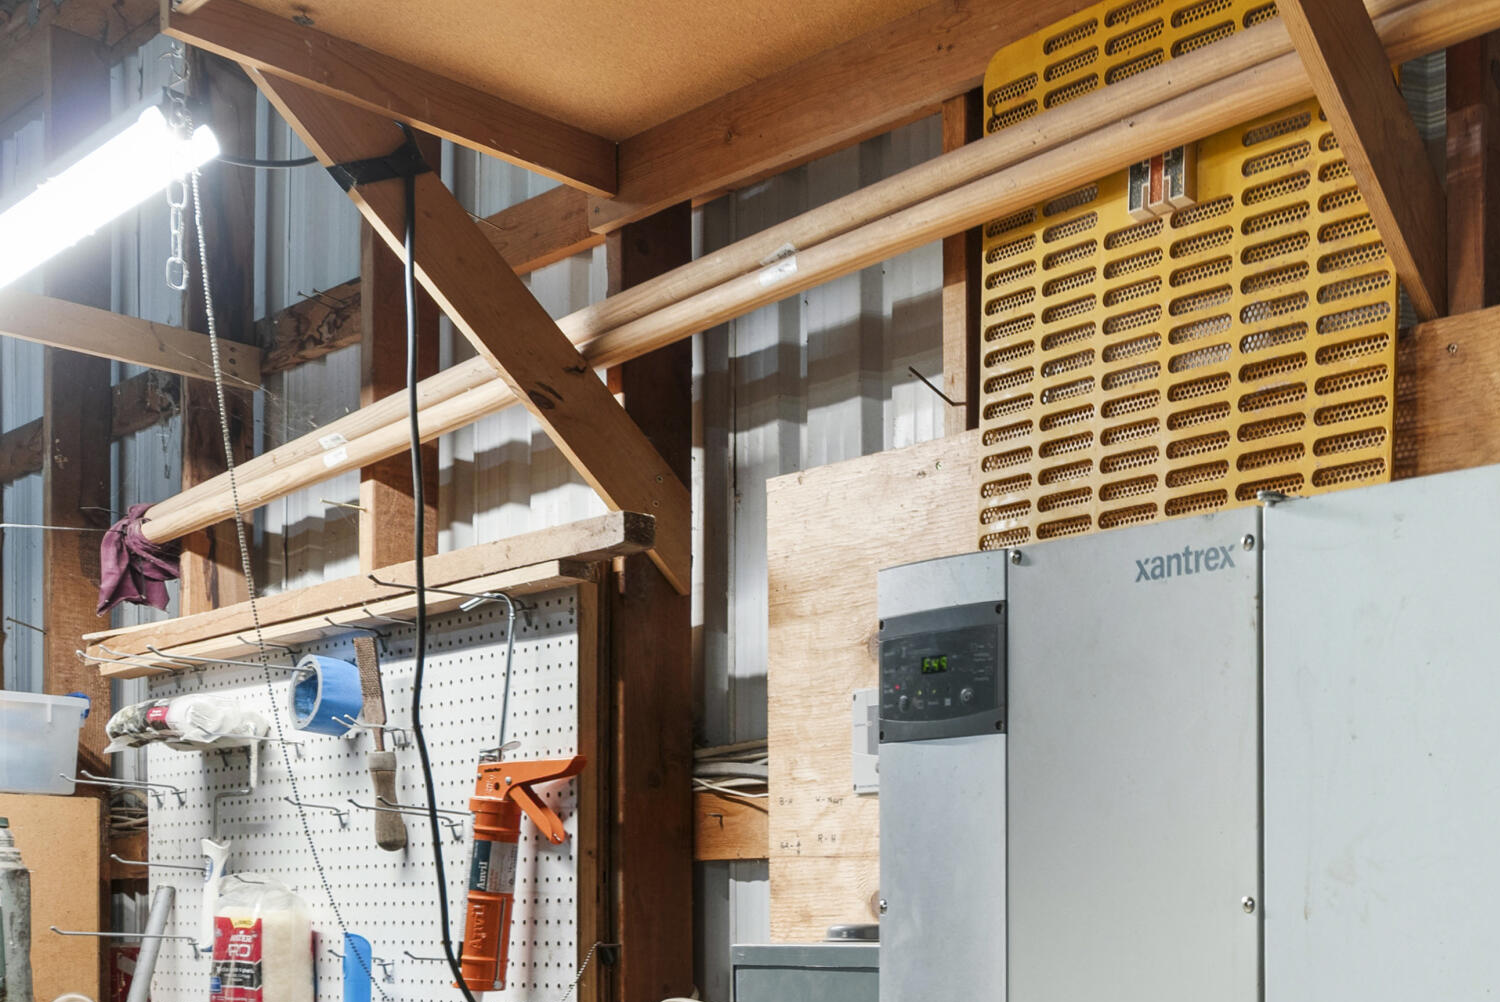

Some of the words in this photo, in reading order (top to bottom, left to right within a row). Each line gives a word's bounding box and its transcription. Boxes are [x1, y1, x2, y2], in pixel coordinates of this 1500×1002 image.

[1135, 544, 1236, 583] xantrex
[476, 861, 488, 889] Anvil
[469, 904, 486, 949] Anvil
